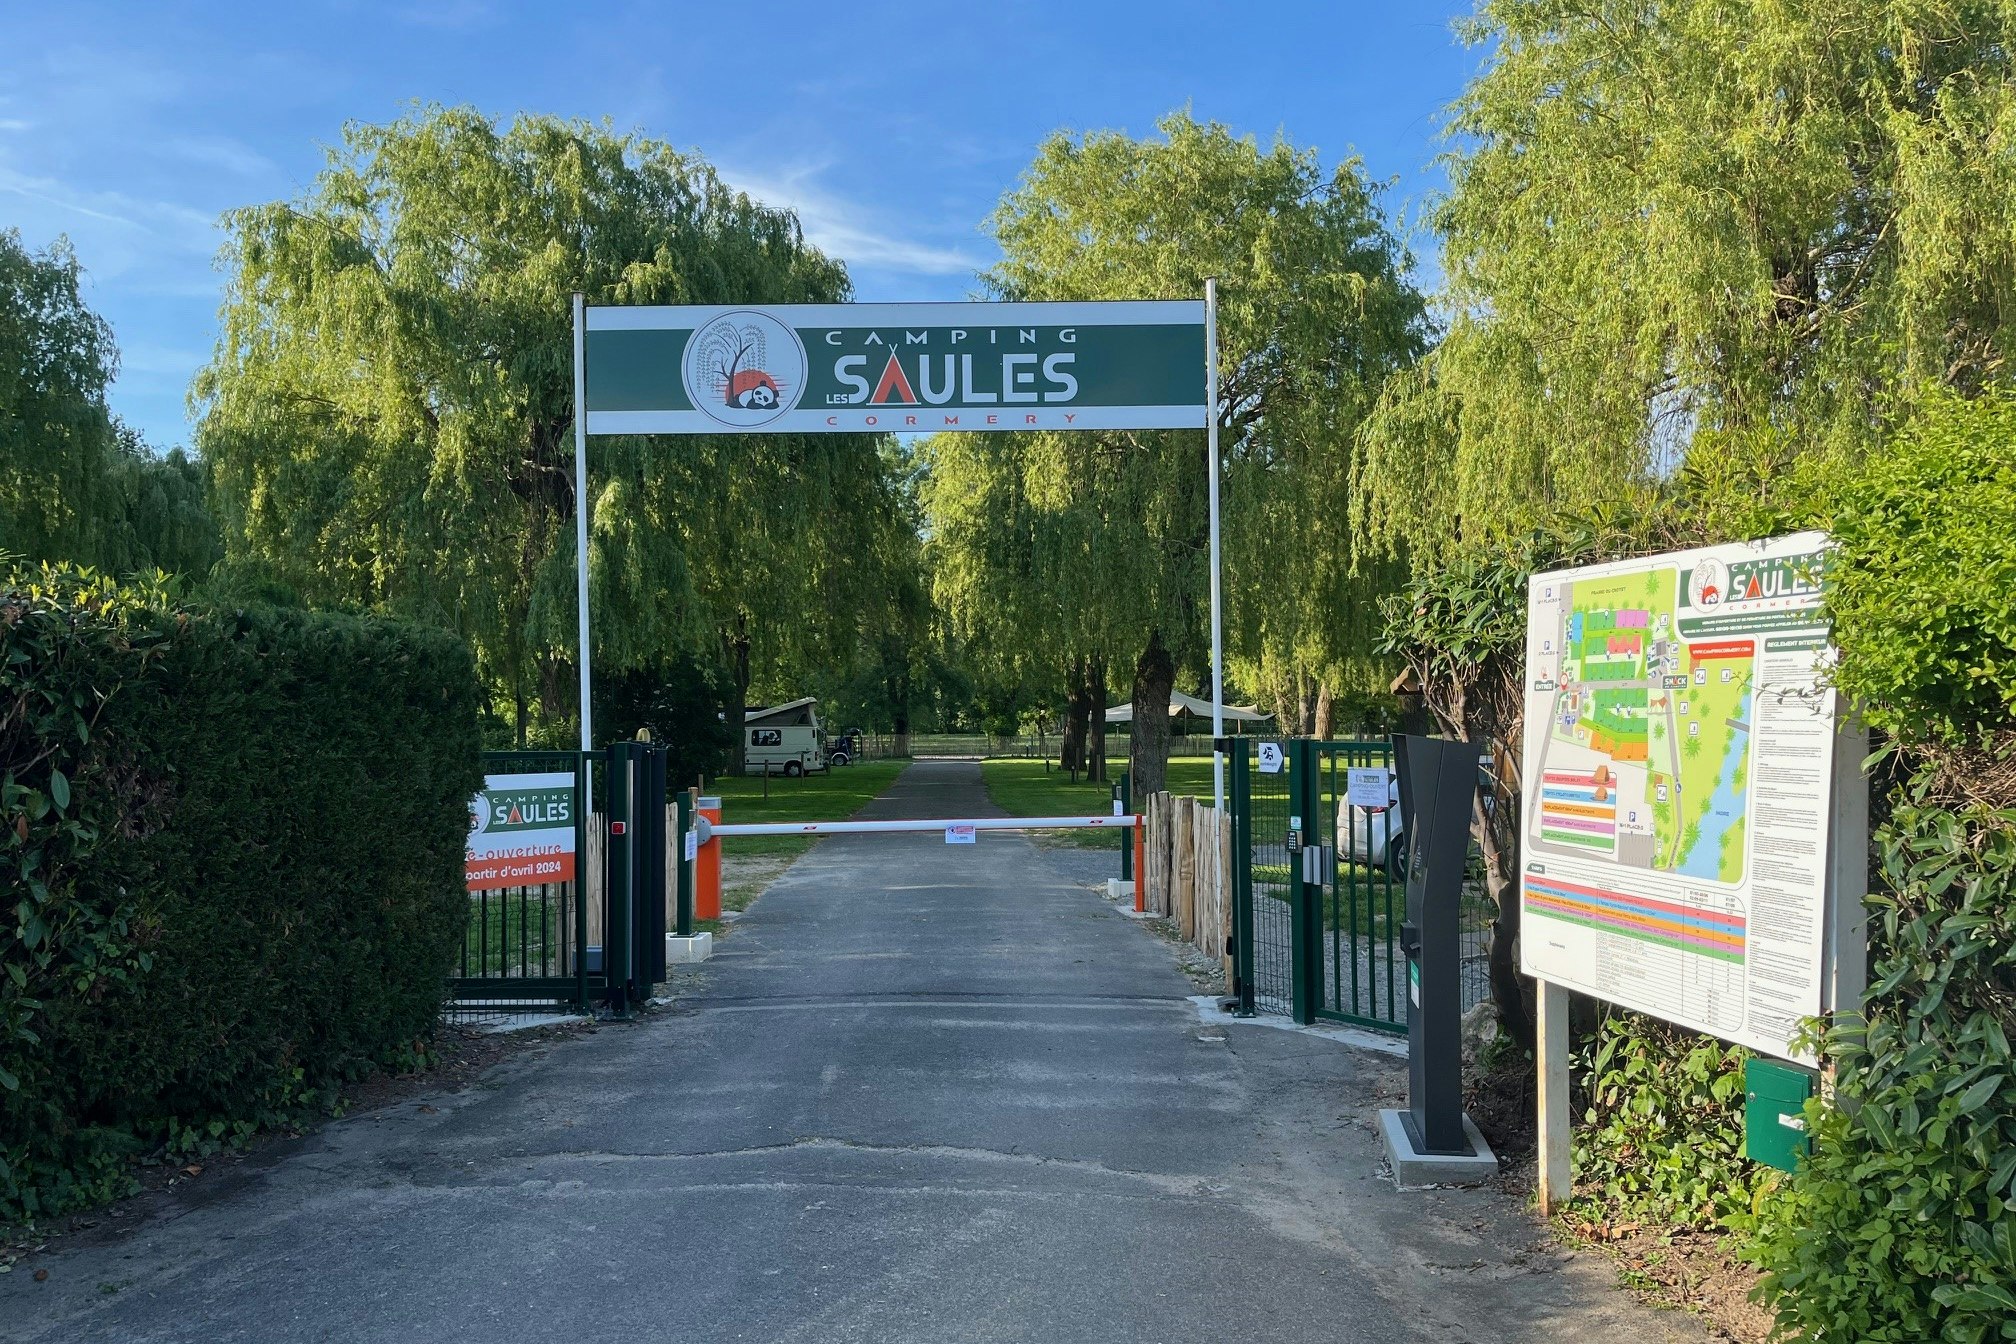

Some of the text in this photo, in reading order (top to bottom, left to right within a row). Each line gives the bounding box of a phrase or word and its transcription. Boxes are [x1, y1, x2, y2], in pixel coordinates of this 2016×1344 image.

[825, 328, 1077, 346] CAMPING
[825, 345, 1078, 406] LES SAULES
[826, 413, 1077, 427] CORMERY
[1731, 553, 1824, 572] CAMPING
[1729, 598, 1807, 611] CORMER
[1664, 675, 1686, 685] SNACK
[493, 793, 569, 803] CAMPING
[495, 802, 569, 825] SAULES
[500, 864, 534, 878] d'avril
[536, 860, 562, 874] 2024
